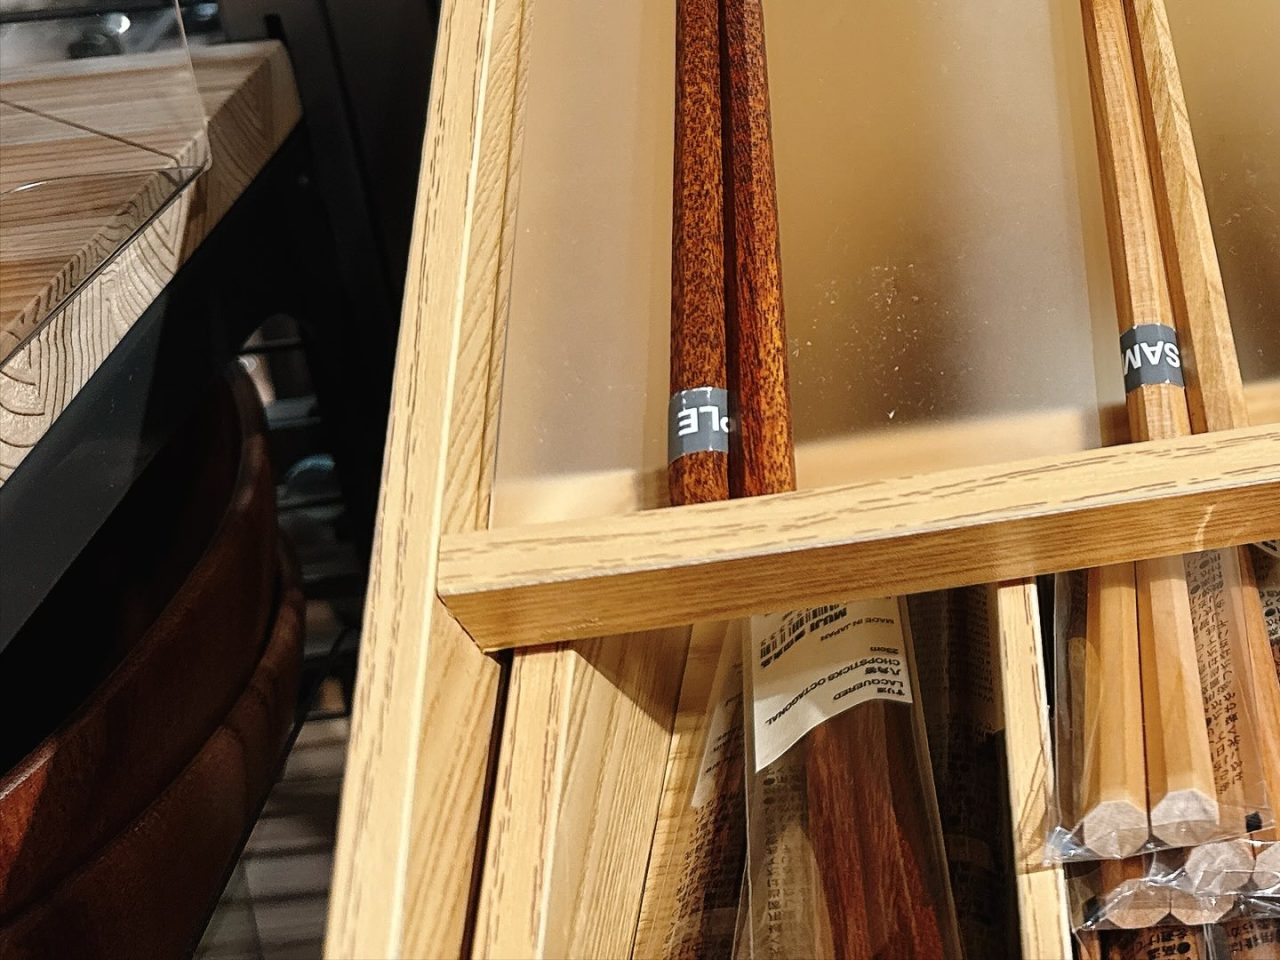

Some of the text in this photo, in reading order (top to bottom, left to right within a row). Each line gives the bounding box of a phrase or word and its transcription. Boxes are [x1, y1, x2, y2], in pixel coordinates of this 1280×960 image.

[810, 607, 847, 632] MUJI
[820, 623, 851, 641] JAPAN
[765, 657, 900, 725] CHOPSTICKS OCTAGONAL
[833, 678, 903, 701] LACQUERED
